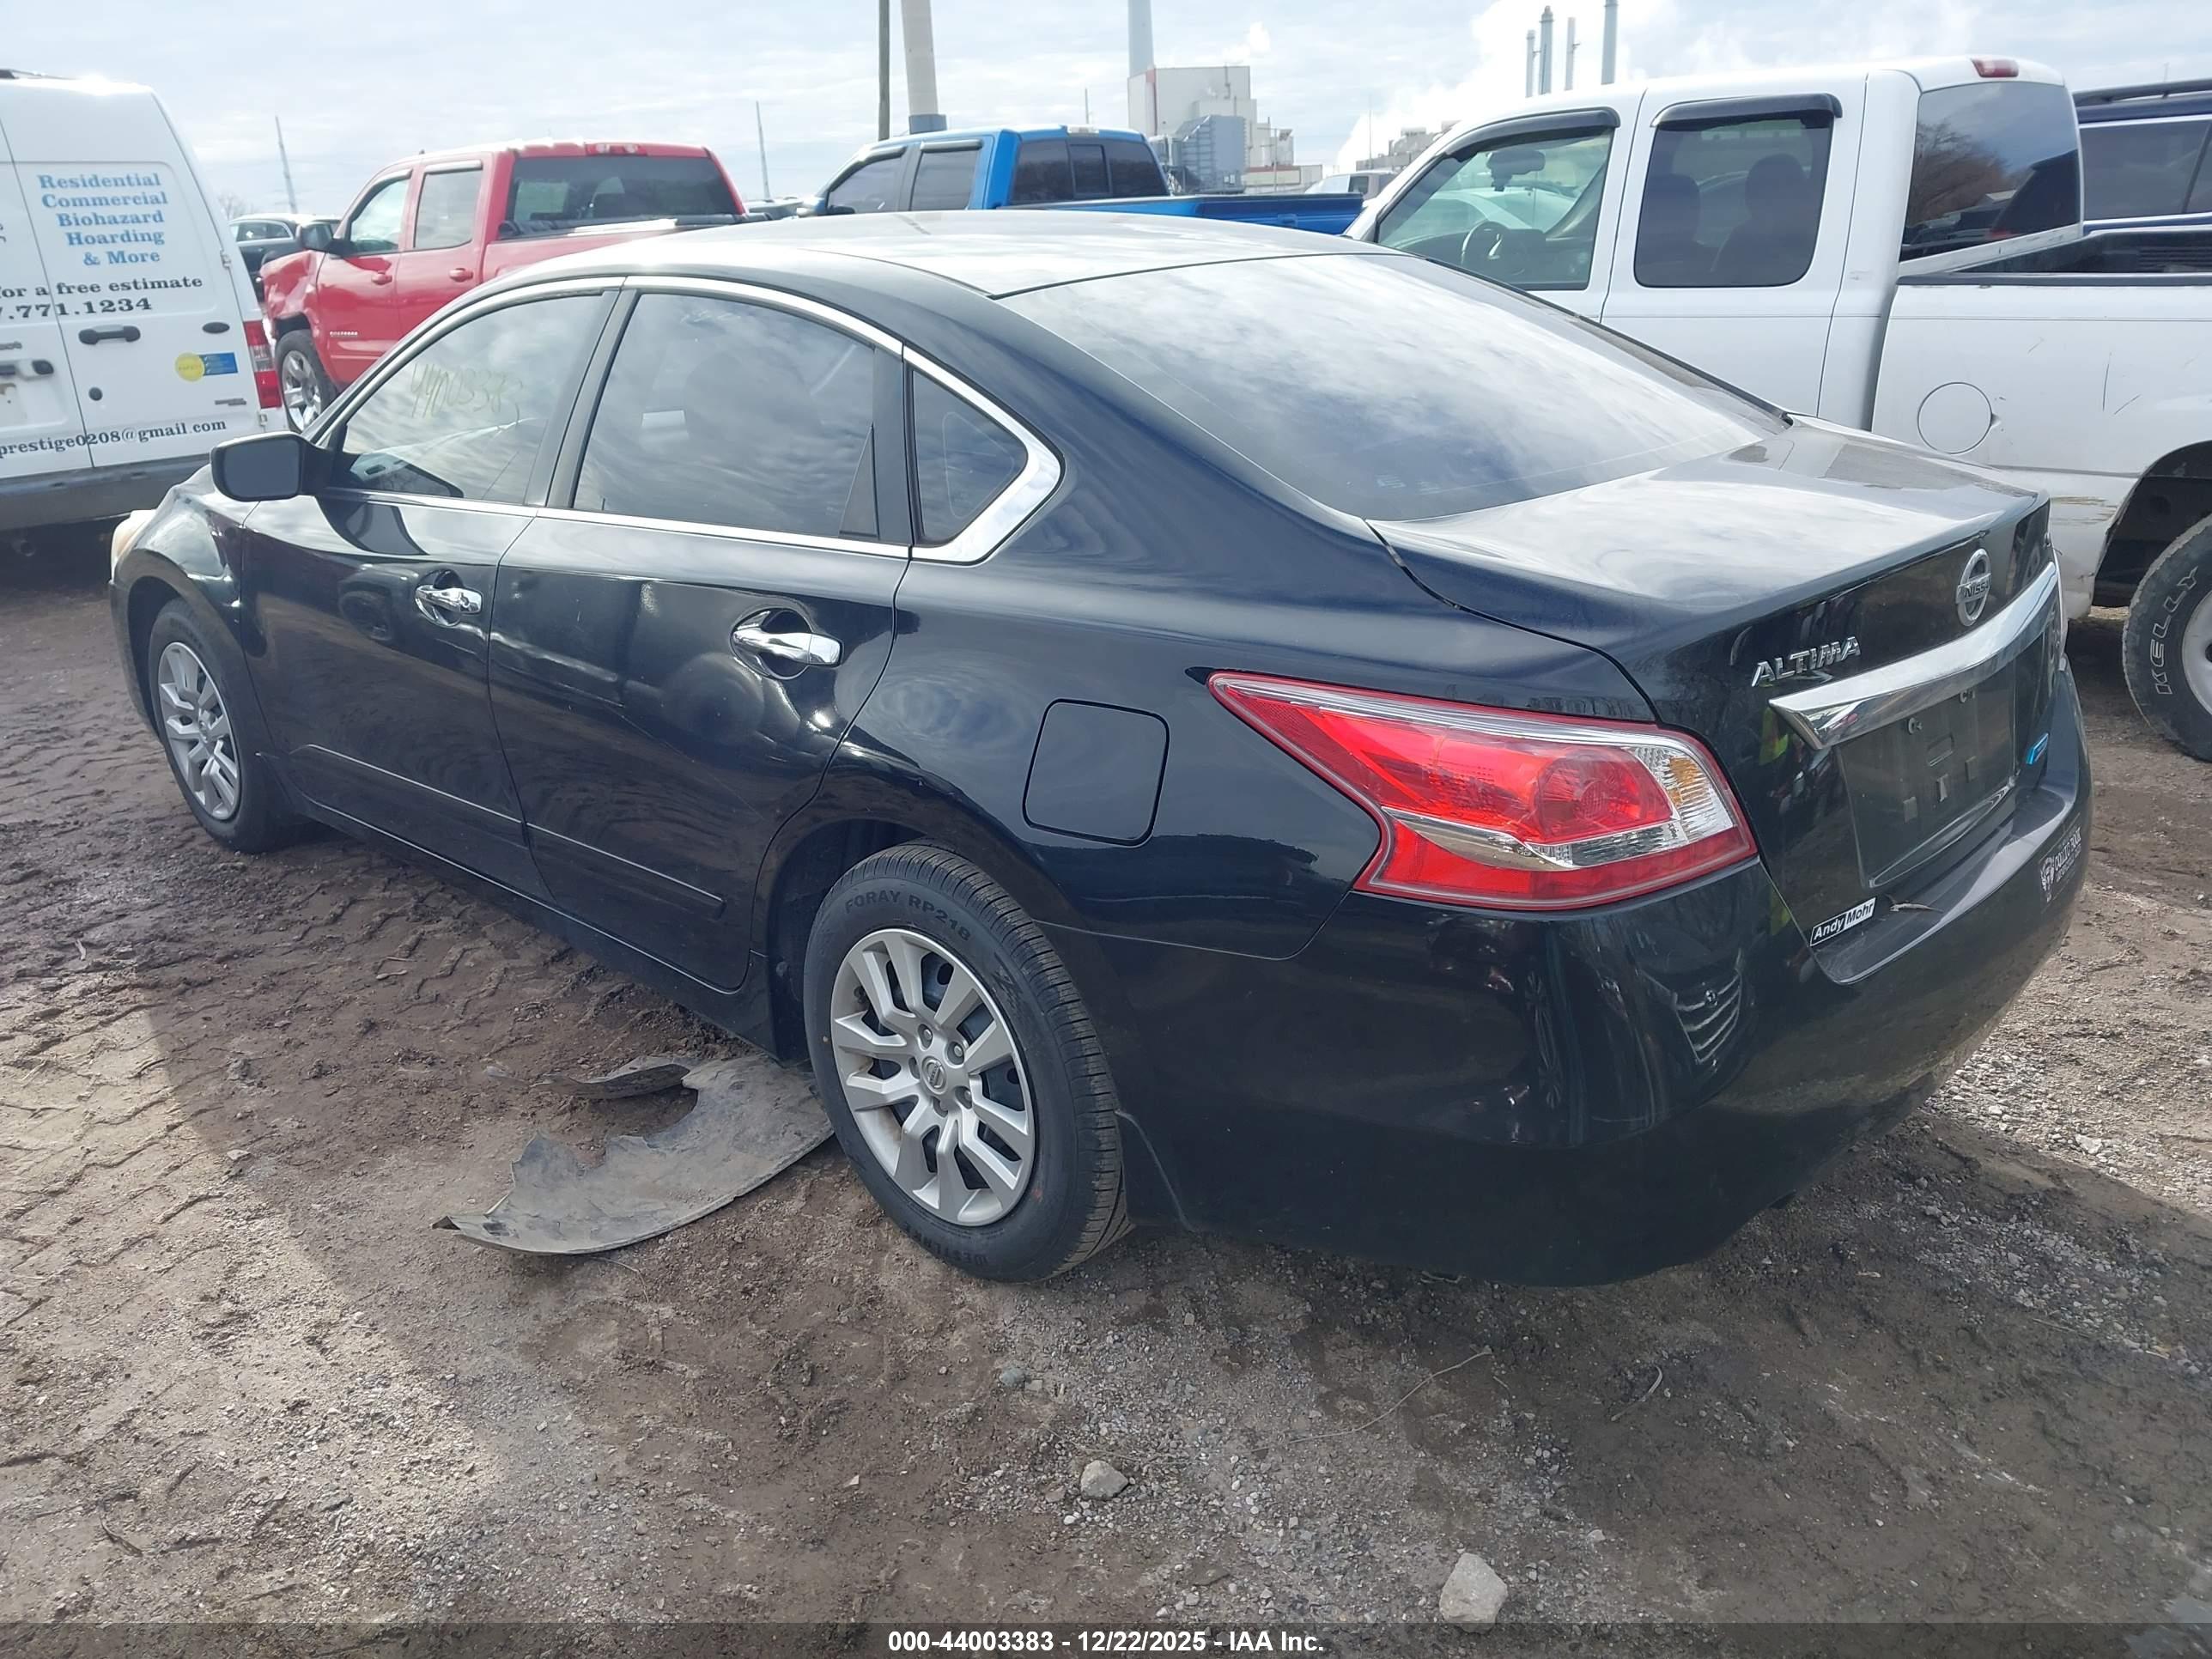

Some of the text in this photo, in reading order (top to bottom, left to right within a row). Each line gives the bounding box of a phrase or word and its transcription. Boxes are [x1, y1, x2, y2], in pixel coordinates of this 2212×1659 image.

[38, 173, 161, 189] Residential
[42, 191, 168, 209] Commercial
[56, 210, 165, 228] Biohazard
[66, 230, 166, 246] Hoarding
[83, 251, 161, 266] & More
[0, 276, 204, 299] or a free estimate
[2150, 565, 2199, 696] KELLY
[1751, 635, 1862, 687] ALTIMA
[844, 890, 972, 942] FORAY RP218
[1814, 902, 1874, 940] Andy Mohr
